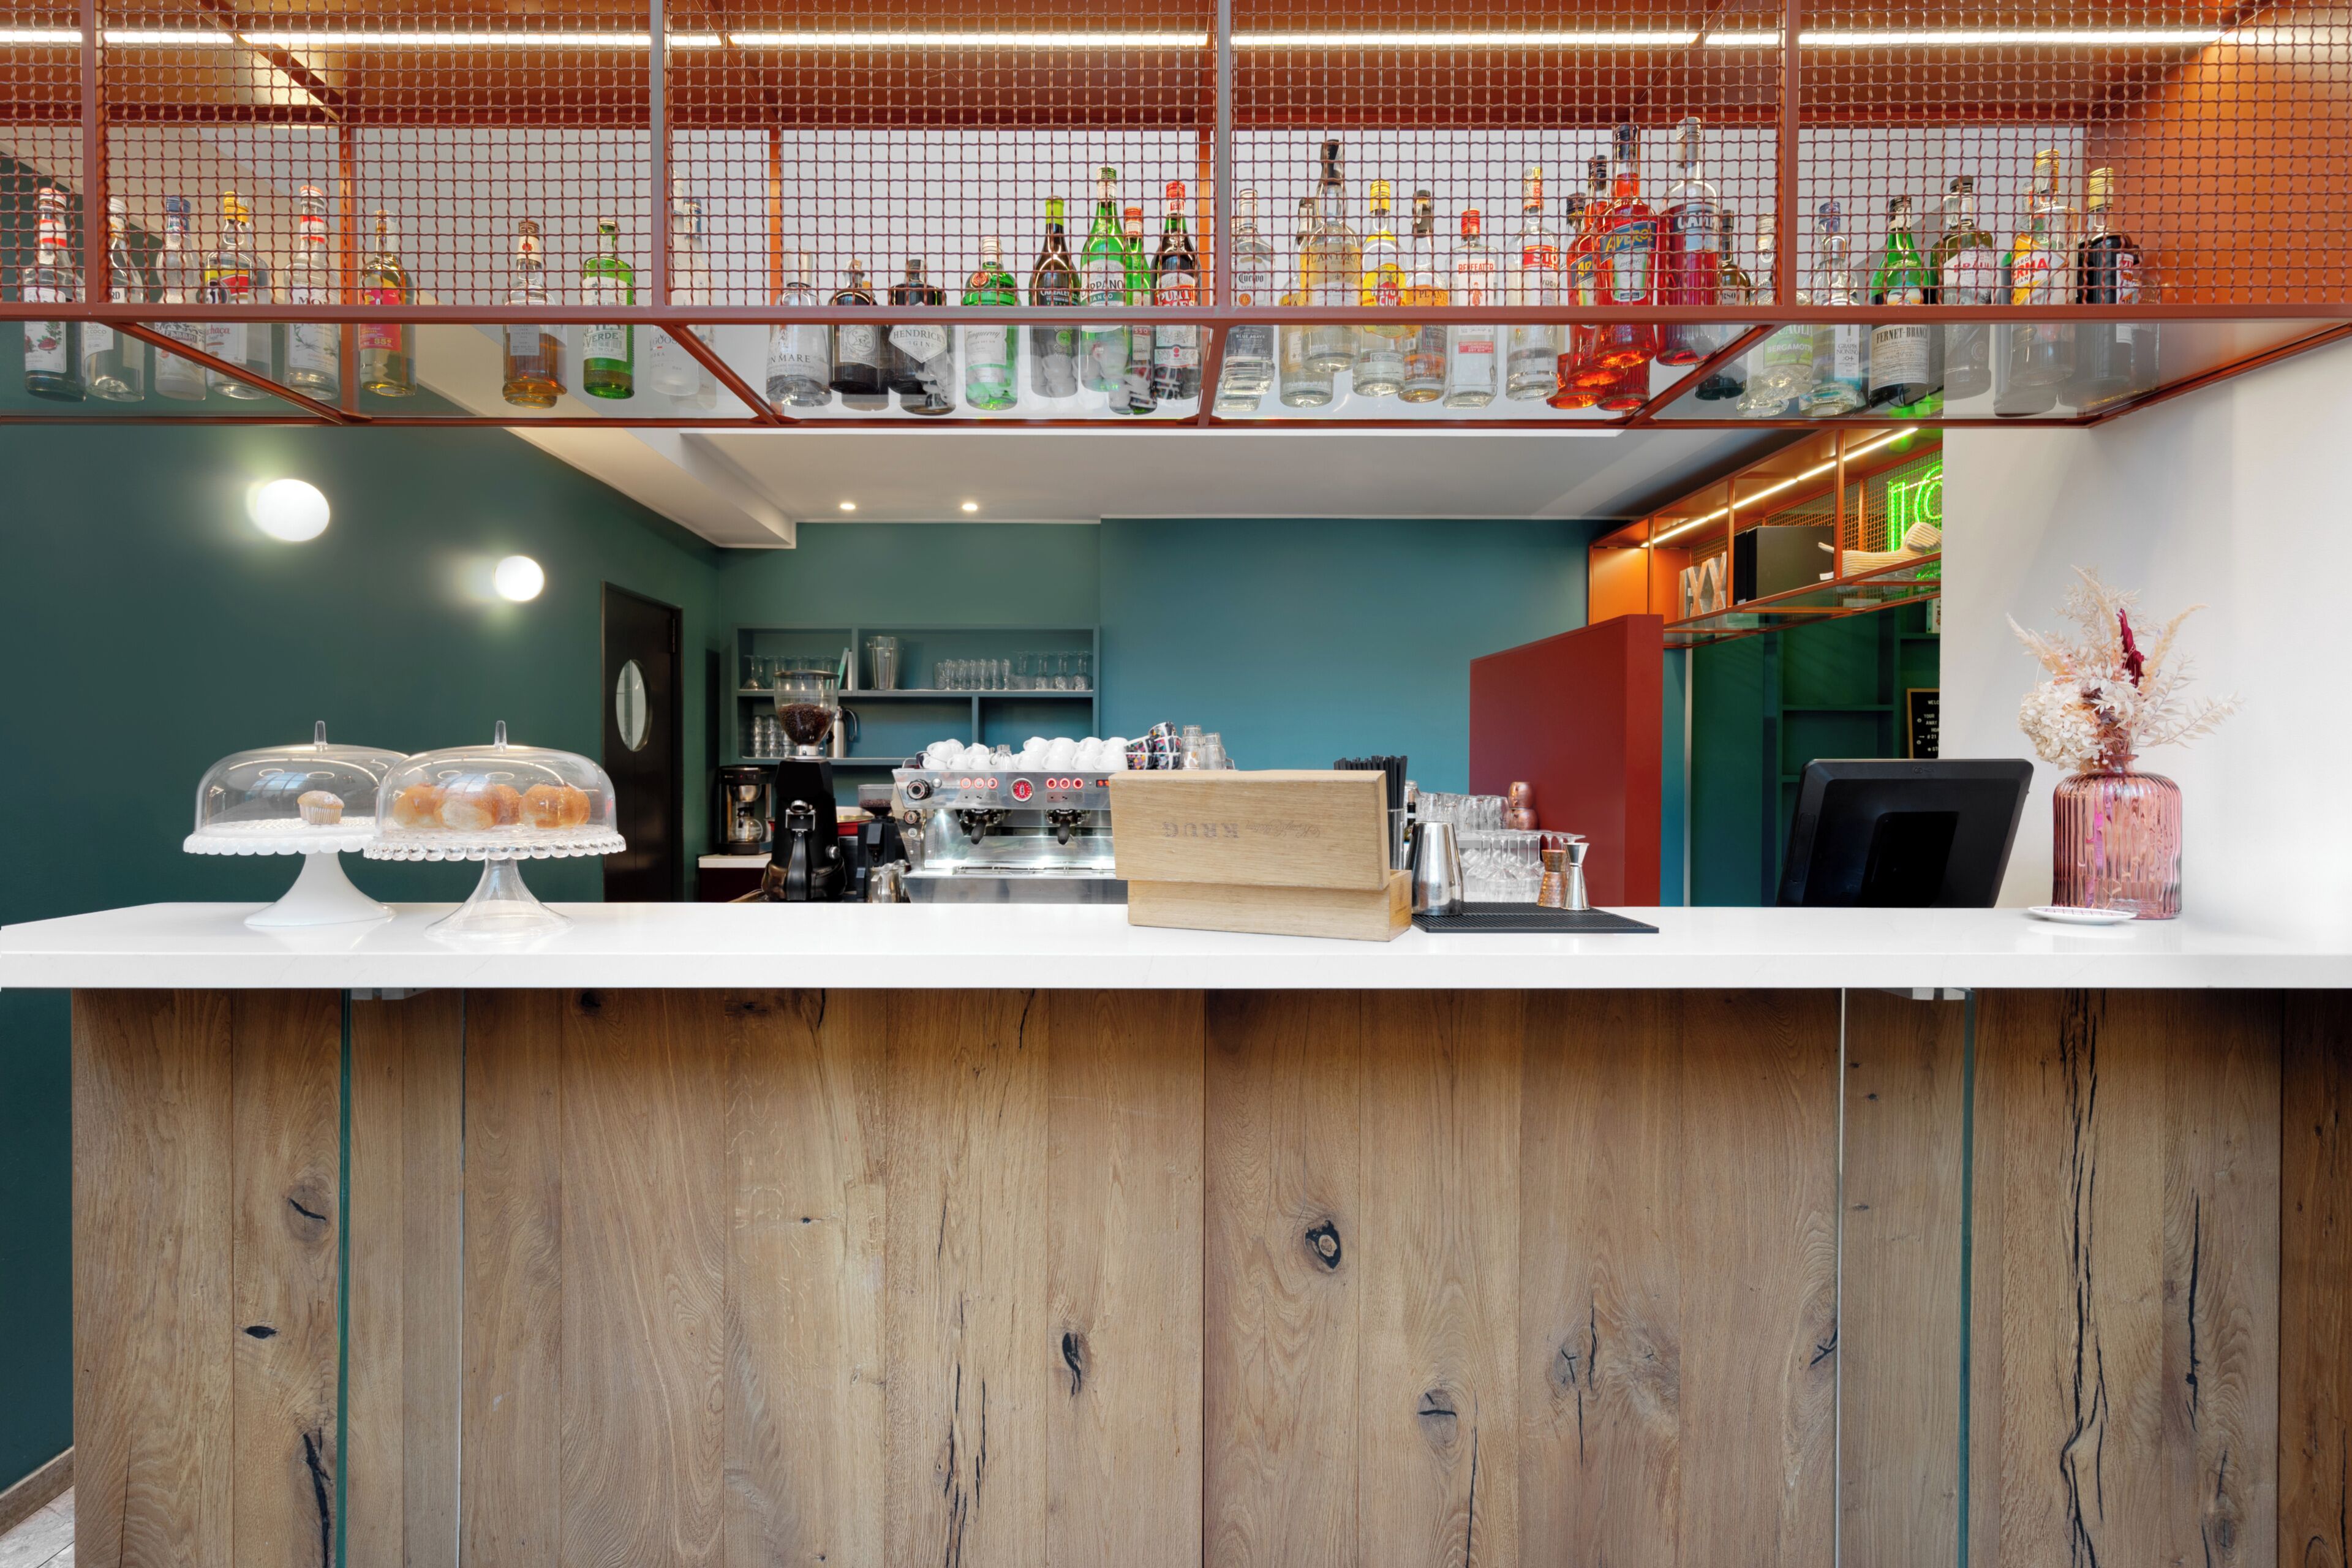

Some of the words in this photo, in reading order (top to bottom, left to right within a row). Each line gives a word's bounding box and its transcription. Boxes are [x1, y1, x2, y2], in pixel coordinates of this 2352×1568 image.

[1577, 261, 1593, 277] AP
[166, 330, 197, 342] FABBRI
[586, 332, 619, 347] VERDE
[777, 353, 811, 363] MARE
[1161, 821, 1240, 839] KRUG
